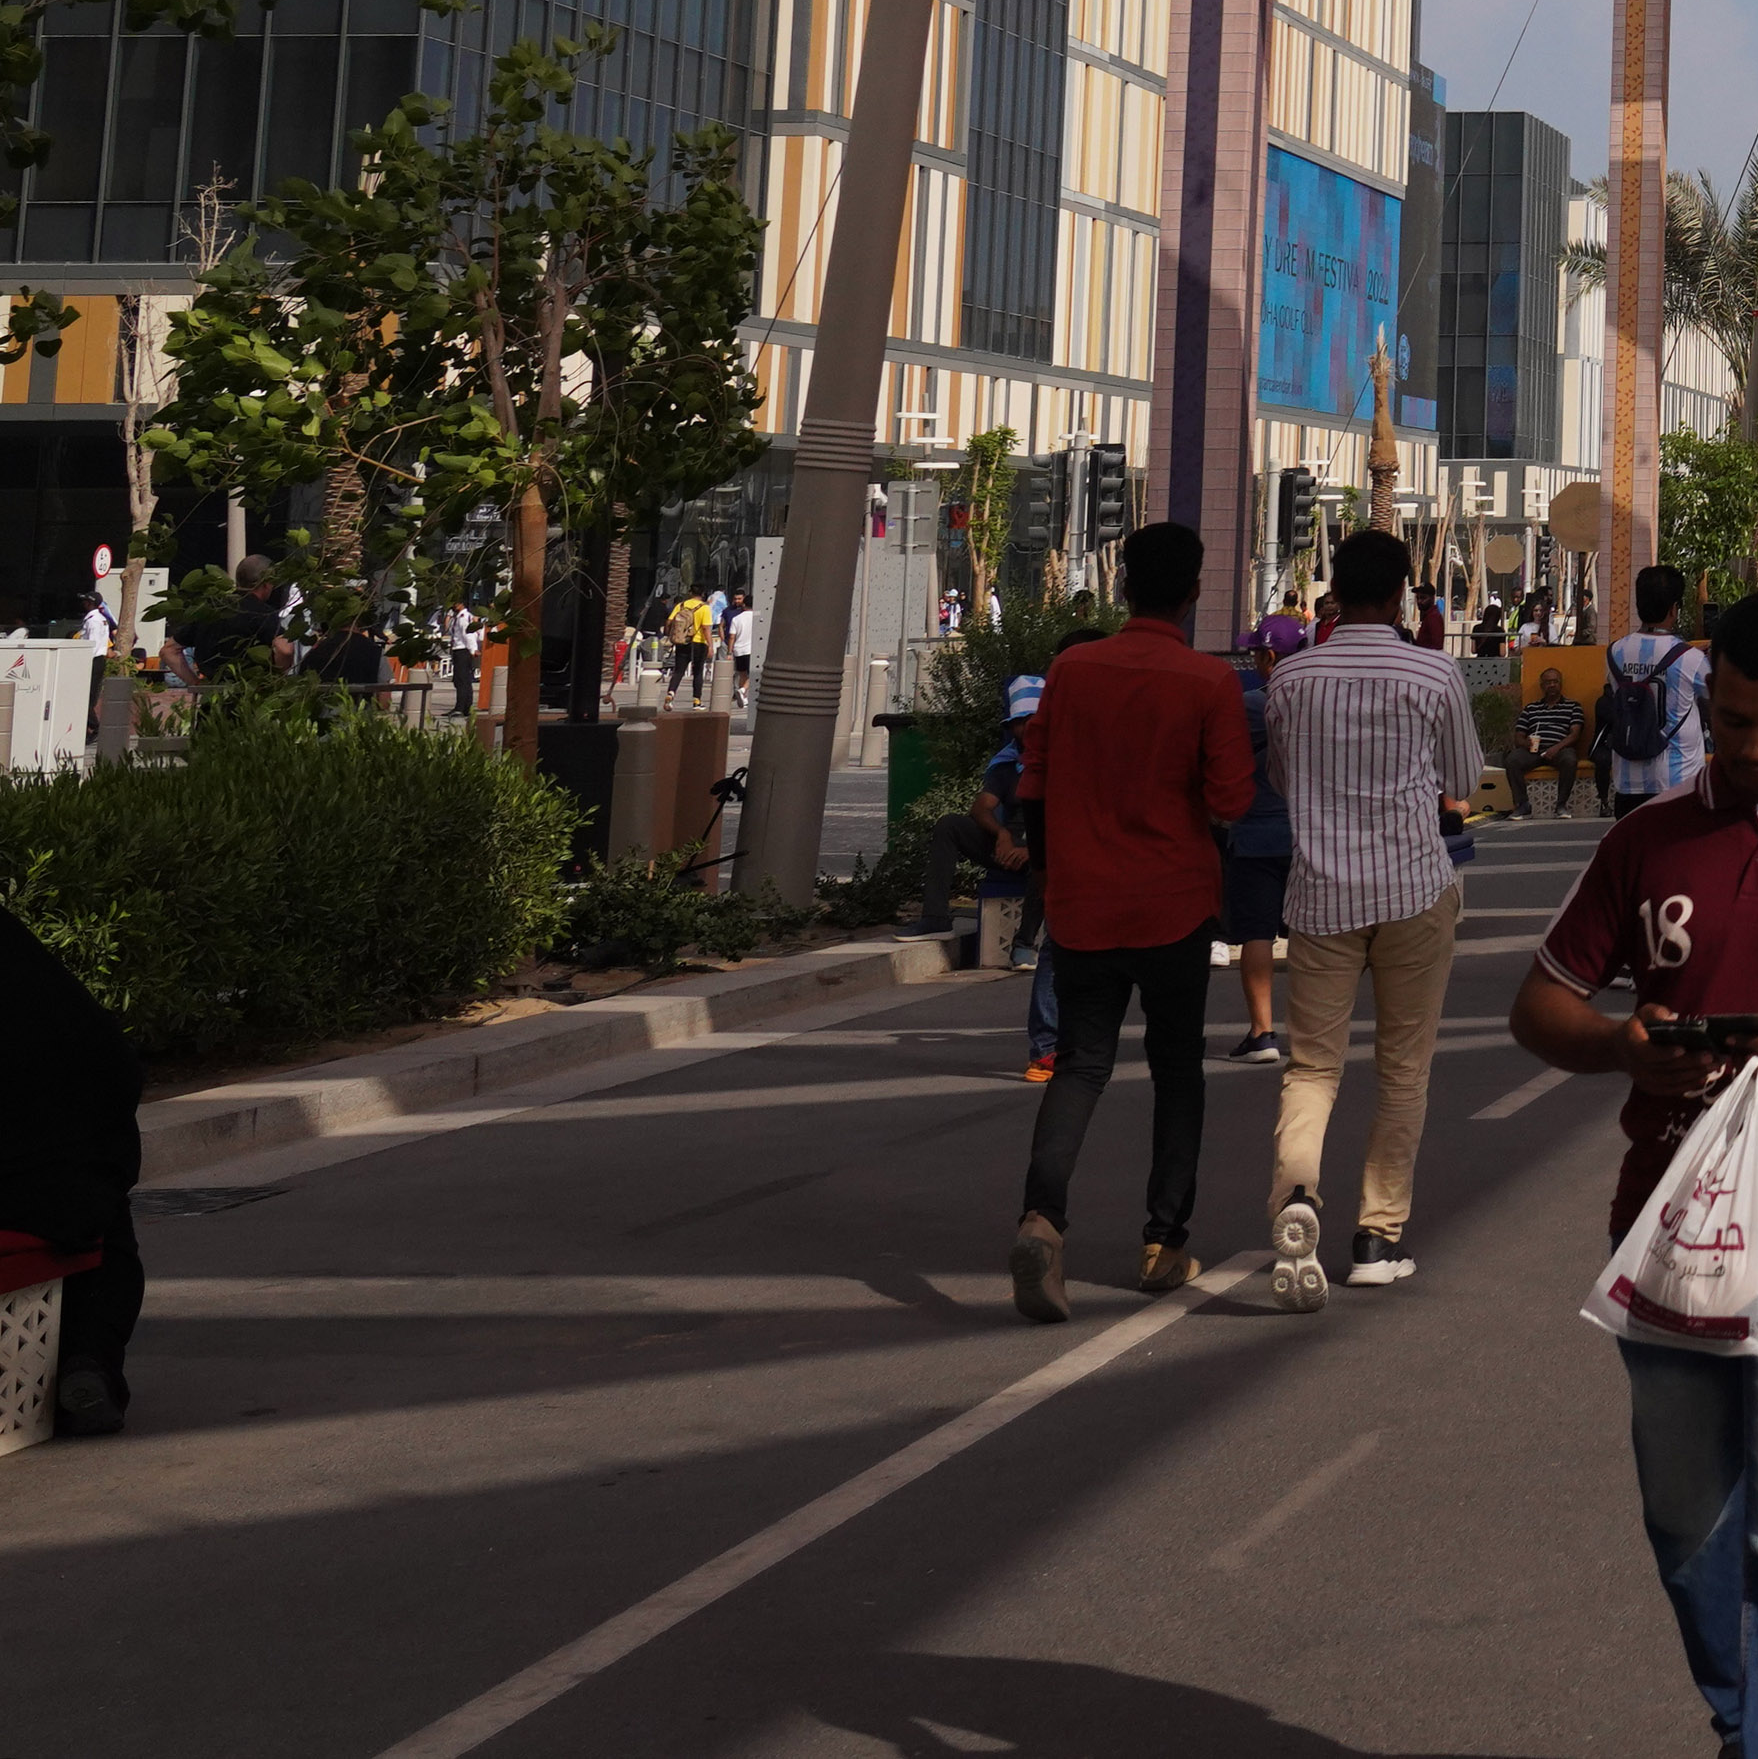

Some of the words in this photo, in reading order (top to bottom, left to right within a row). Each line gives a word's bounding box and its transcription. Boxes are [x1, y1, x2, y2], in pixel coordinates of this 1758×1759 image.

[1275, 238, 1317, 283] DREM
[1319, 252, 1360, 295] FESTIVA
[1367, 269, 1389, 305] 2022
[1261, 299, 1279, 327] OHA
[1639, 894, 1694, 970] 18
